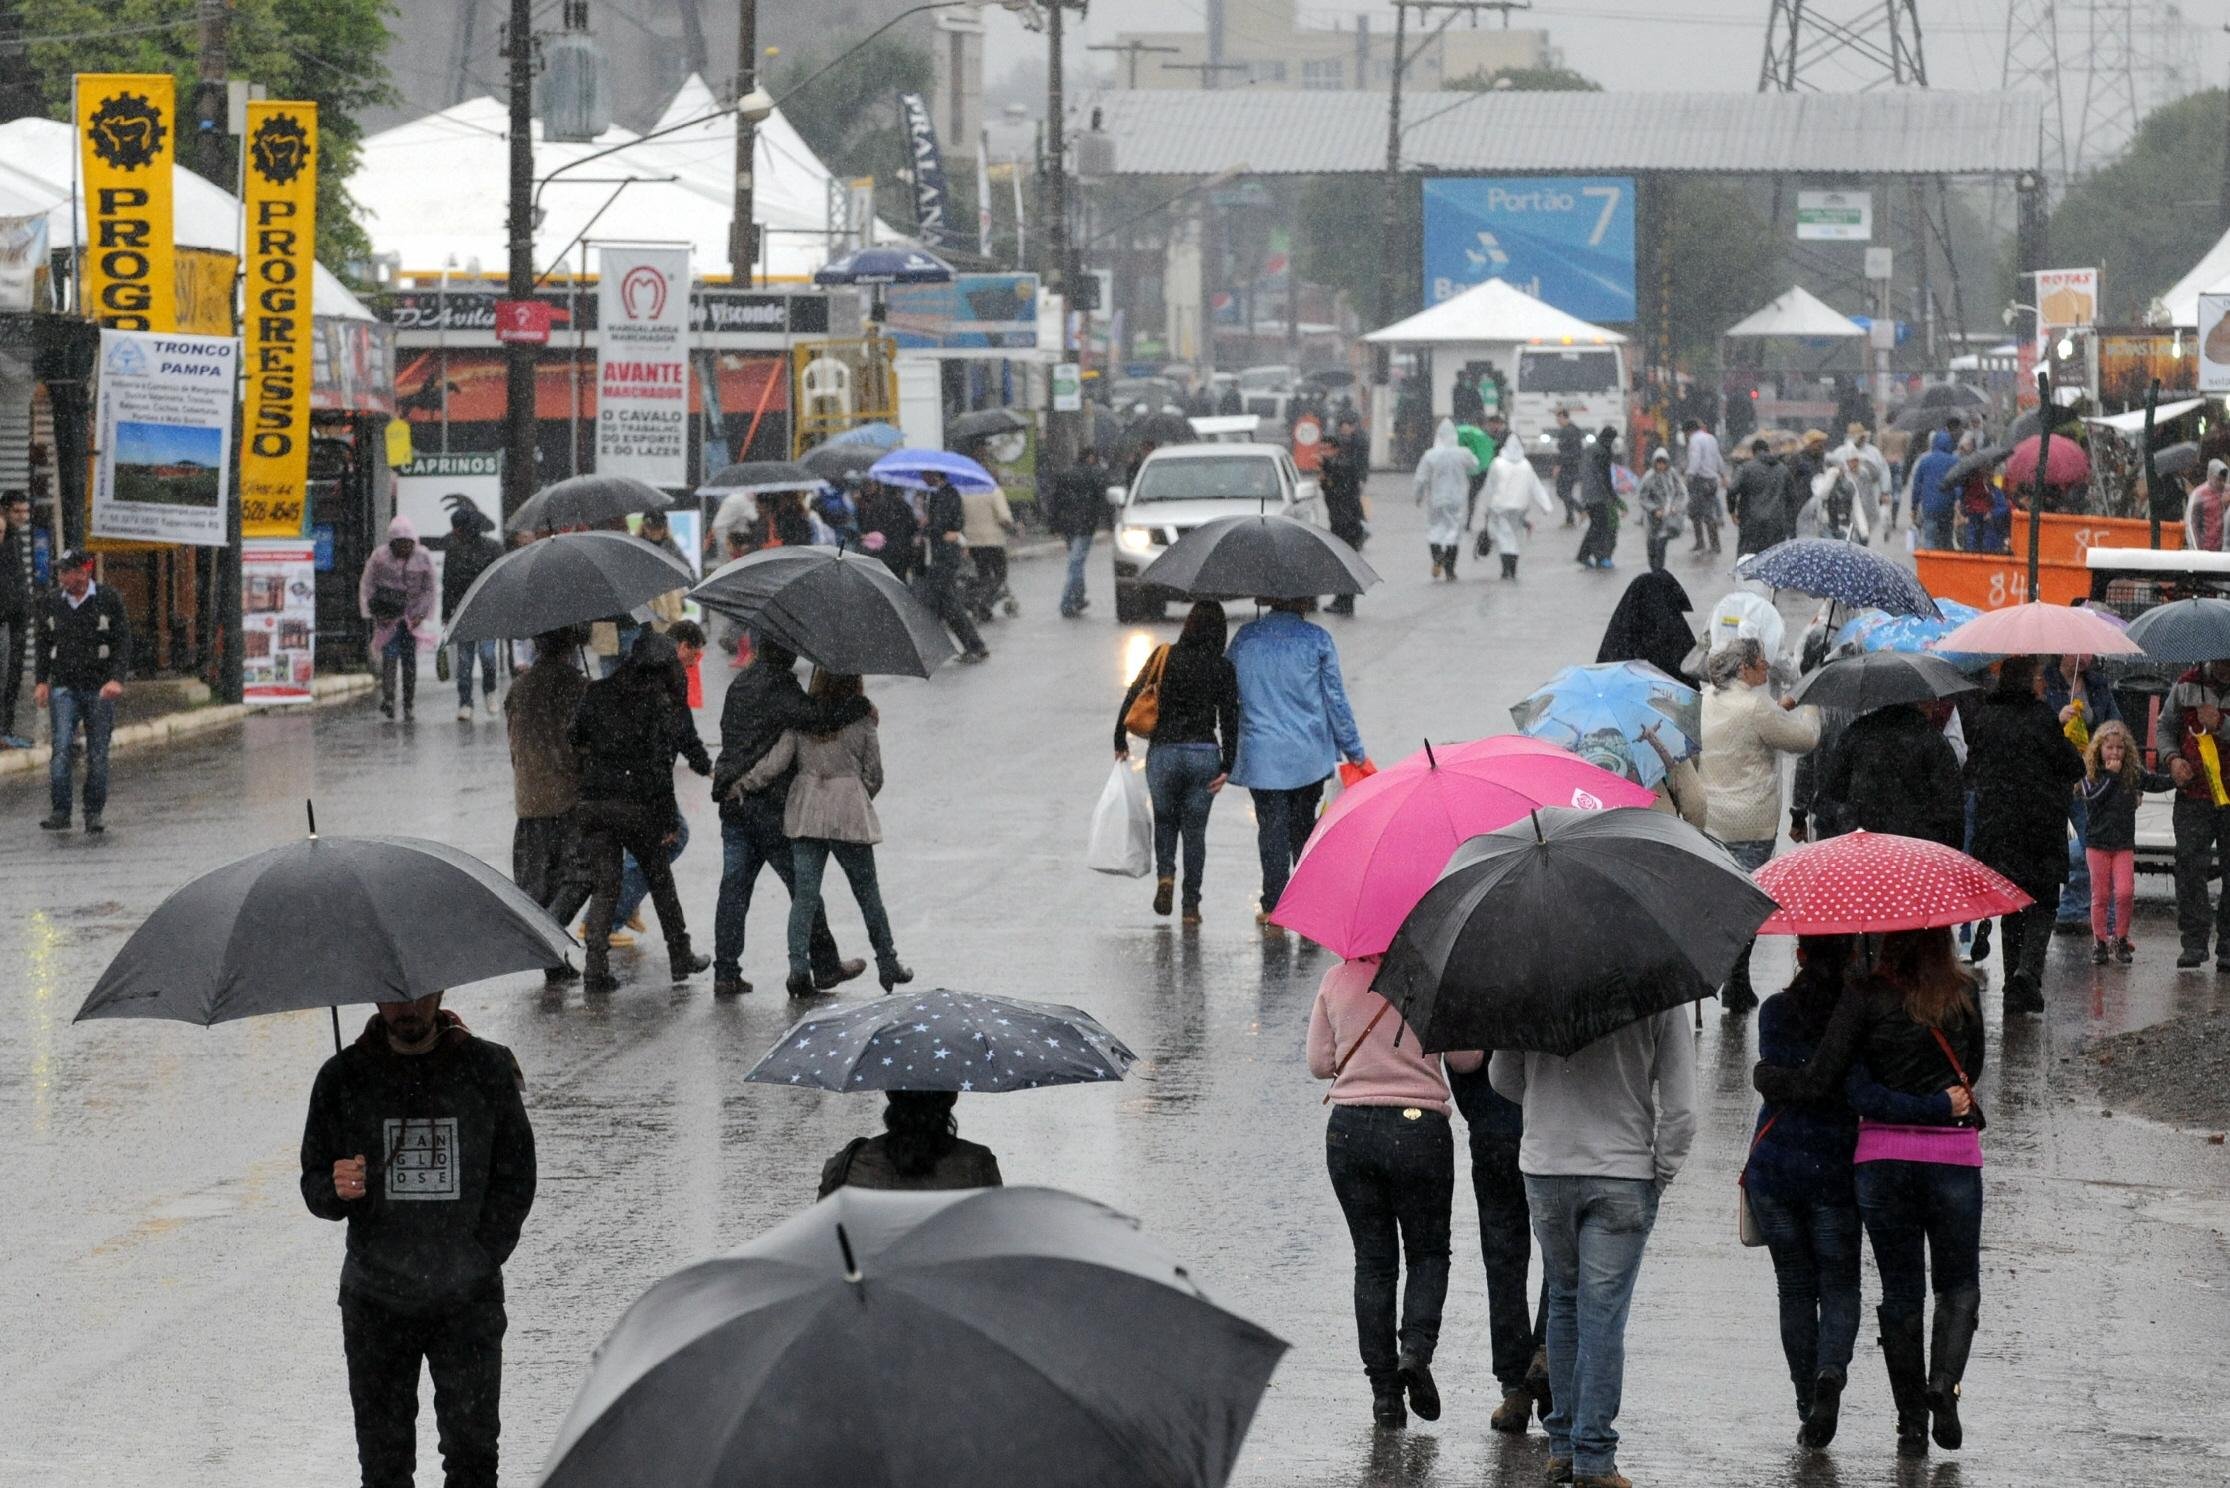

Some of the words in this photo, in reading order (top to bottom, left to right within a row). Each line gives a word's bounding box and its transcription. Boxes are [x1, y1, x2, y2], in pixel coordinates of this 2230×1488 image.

[1488, 187, 1574, 211] Portão
[1583, 186, 1621, 246] 7
[1434, 275, 1541, 300] Baul
[252, 200, 297, 458] PROGRESSO
[154, 340, 231, 357] TRONCO
[160, 362, 222, 377] PAMPA
[604, 361, 682, 383] AVANTE
[602, 410, 613, 421] O
[618, 410, 682, 422] CAVALO
[624, 433, 680, 444] ESPORTE
[601, 445, 609, 454] E
[614, 445, 632, 456] DO
[638, 446, 680, 456] LAZER
[401, 457, 496, 473] CAPRINOS
[1989, 571, 2028, 606] 84
